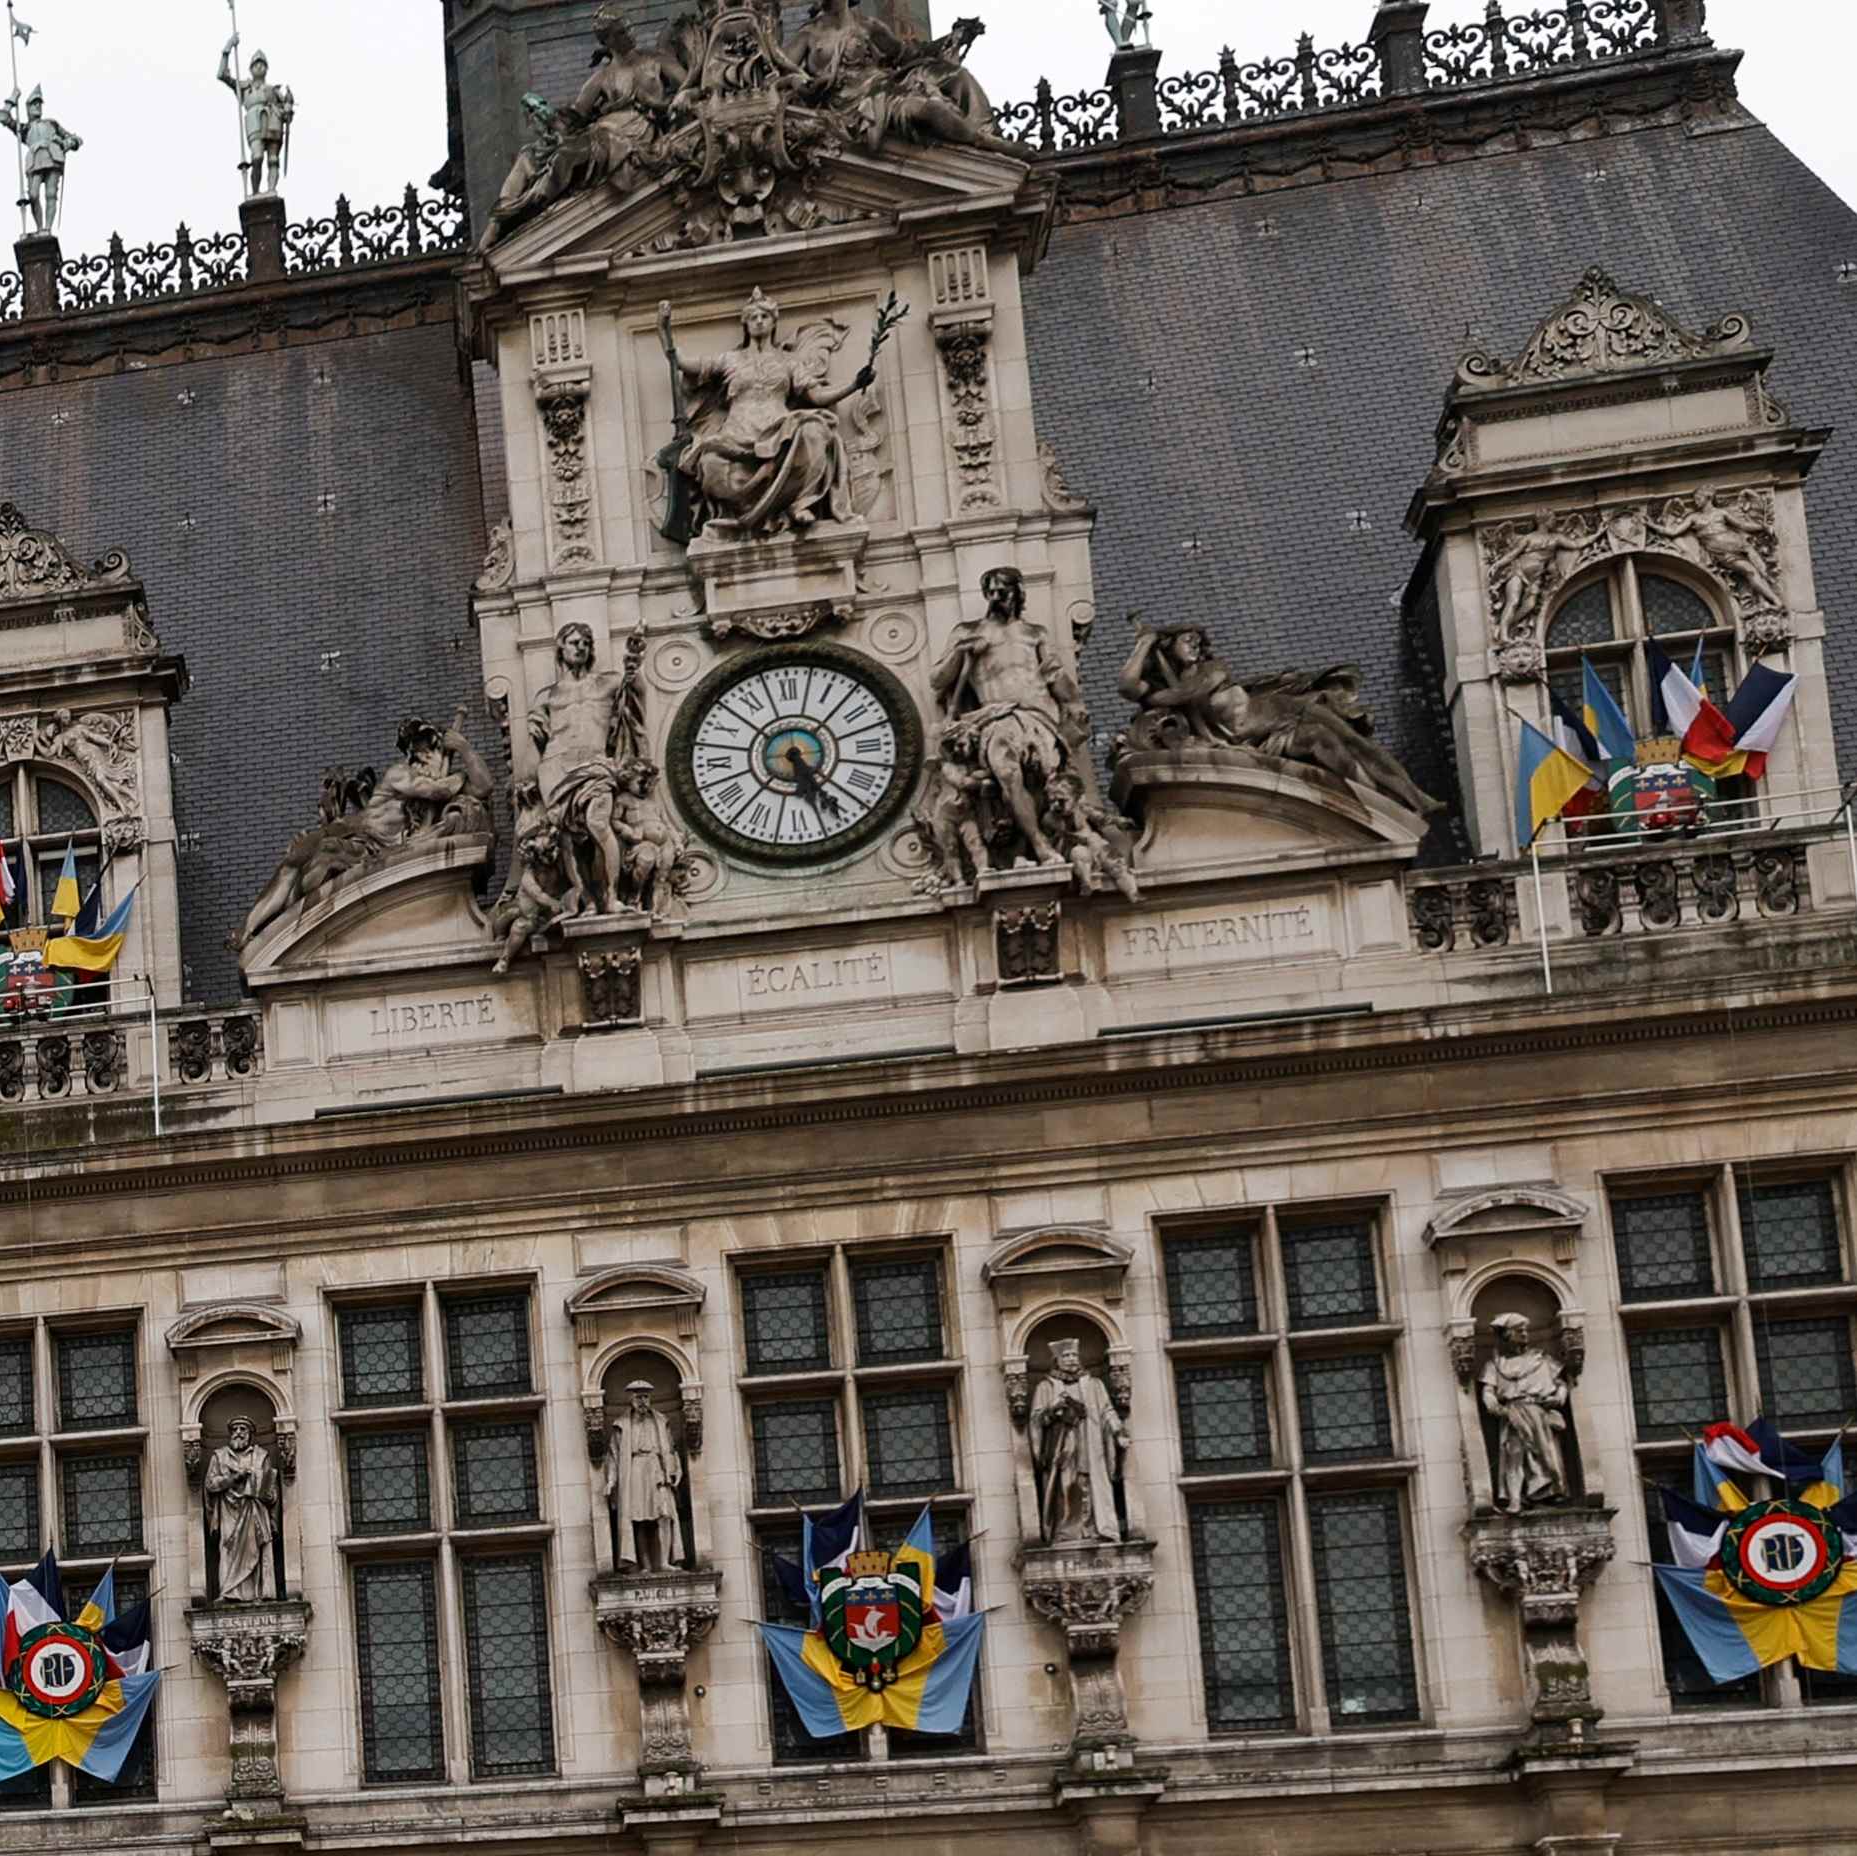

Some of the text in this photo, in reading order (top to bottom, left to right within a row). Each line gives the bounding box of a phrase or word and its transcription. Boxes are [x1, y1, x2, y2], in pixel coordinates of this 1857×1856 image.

[1121, 904, 1314, 957] FRATERNITÉ
[369, 993, 496, 1036] LIBERTÉ
[1758, 1533, 1805, 1574] RF
[39, 1653, 76, 1689] RF
